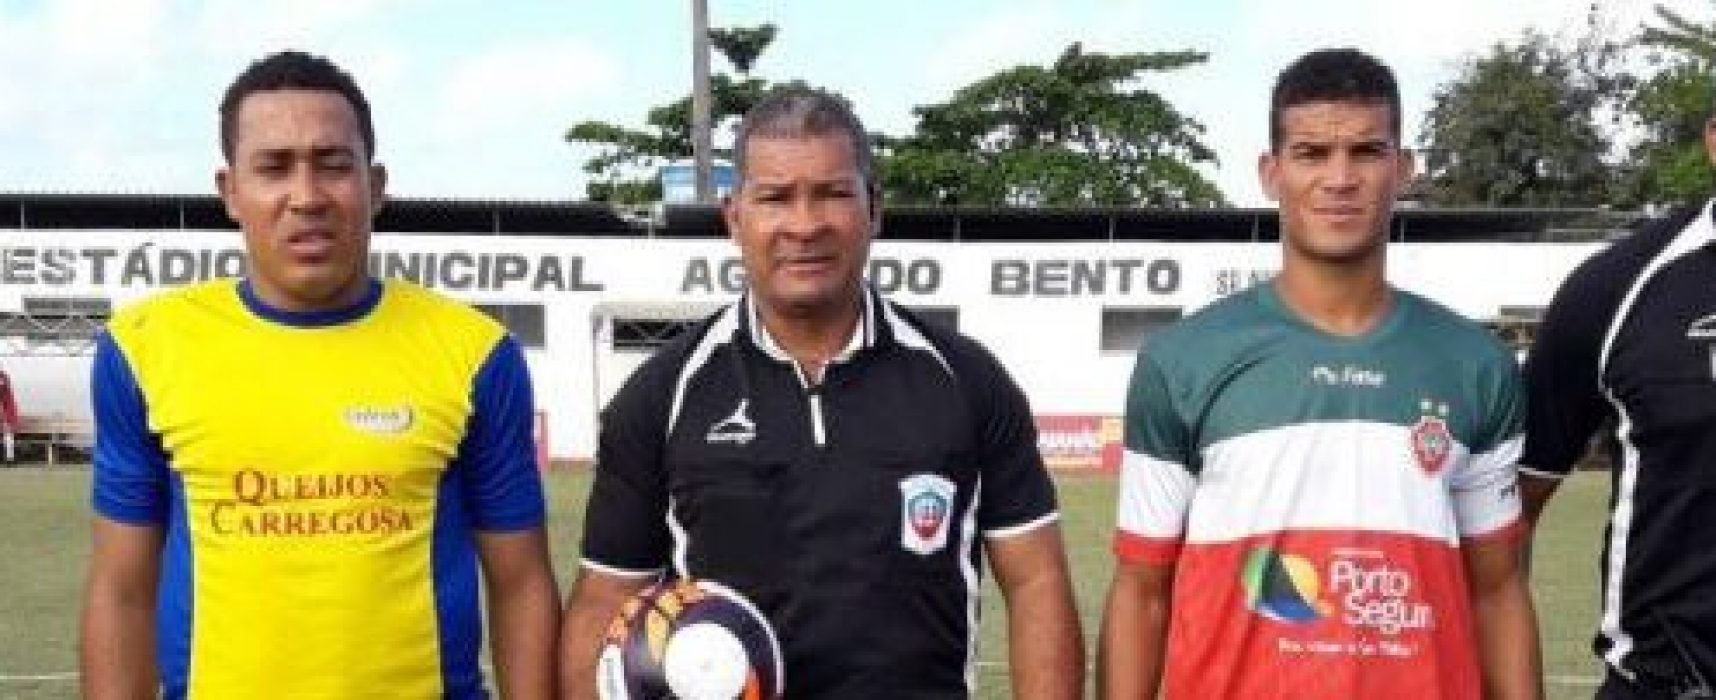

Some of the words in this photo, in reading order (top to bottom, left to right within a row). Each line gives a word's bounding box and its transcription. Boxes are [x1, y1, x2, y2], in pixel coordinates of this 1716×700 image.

[2, 241, 247, 286] ESTÁDIO
[368, 252, 604, 291] NICIPAL
[681, 256, 942, 294] AGDO
[990, 259, 1182, 295] BENTO
[1330, 560, 1409, 598] Porto
